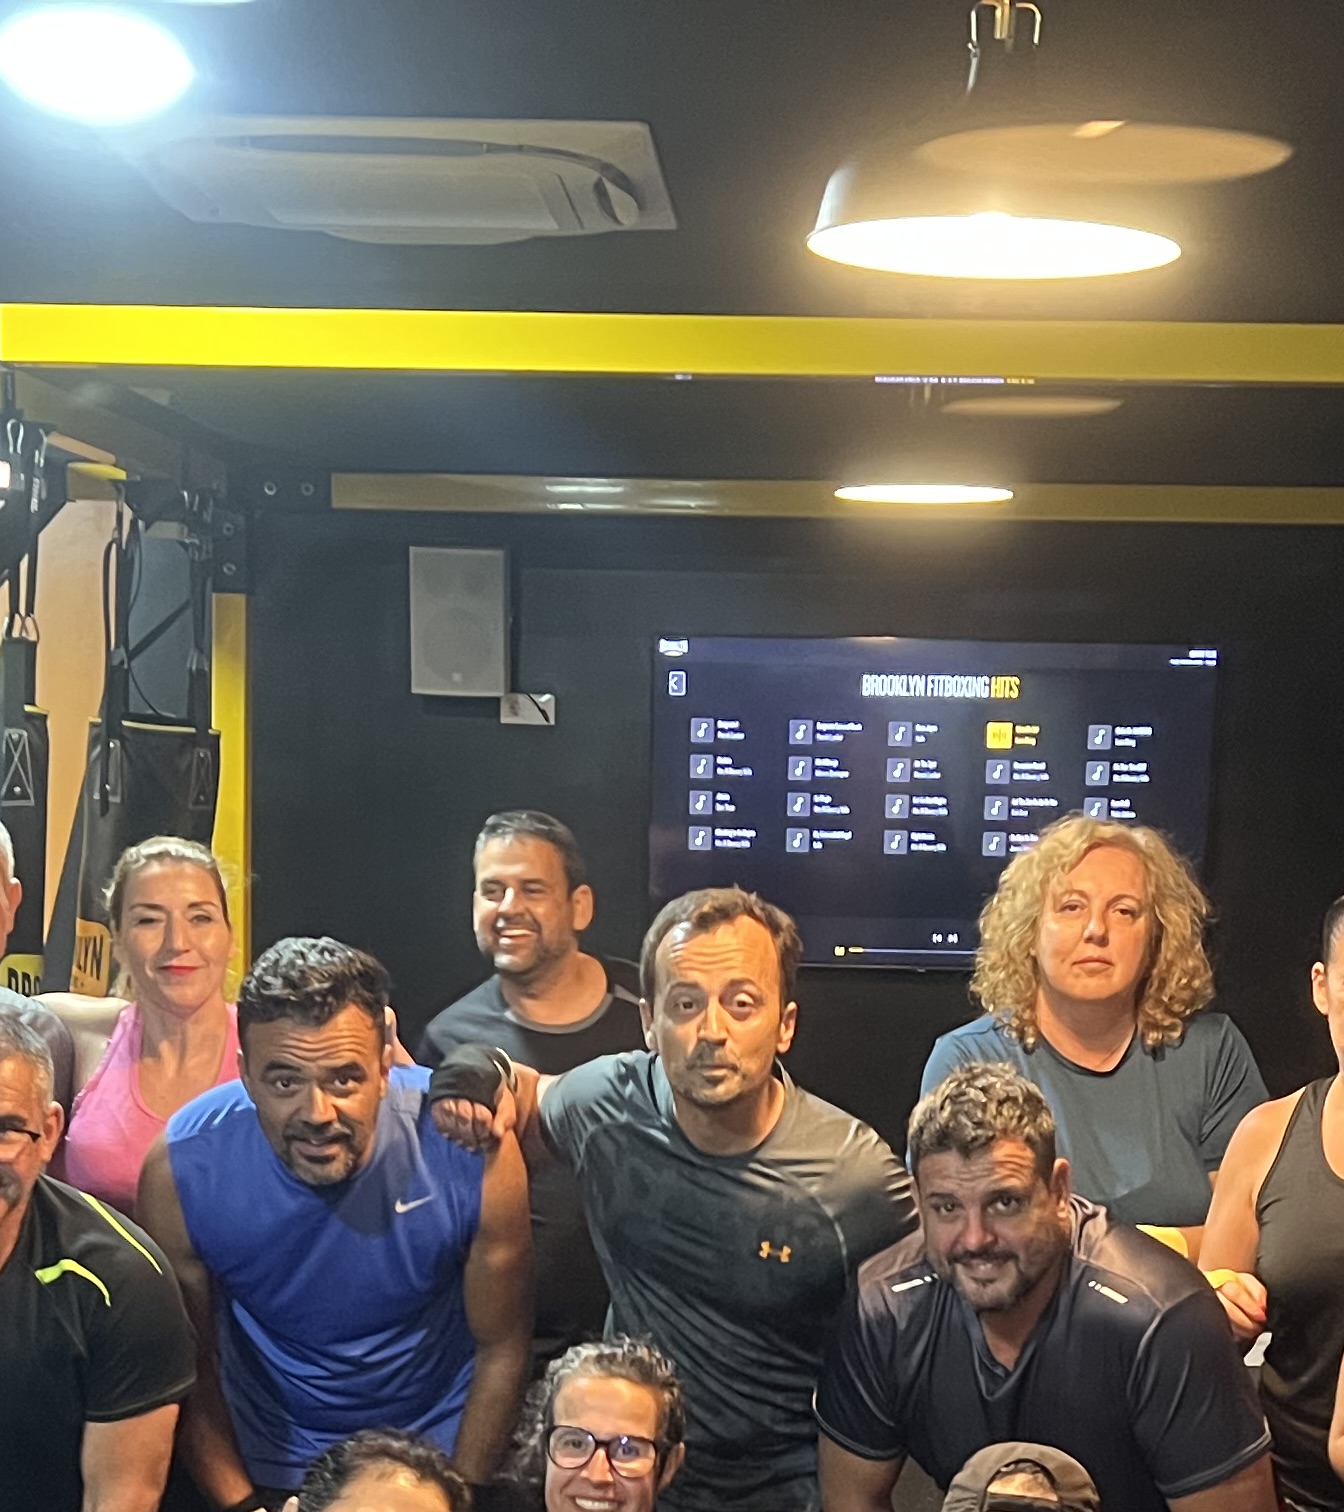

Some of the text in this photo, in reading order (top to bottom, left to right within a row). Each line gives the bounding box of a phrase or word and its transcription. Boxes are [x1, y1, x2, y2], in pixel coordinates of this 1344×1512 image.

[862, 674, 1021, 698] BROOKLYN FITBOXING HITS
